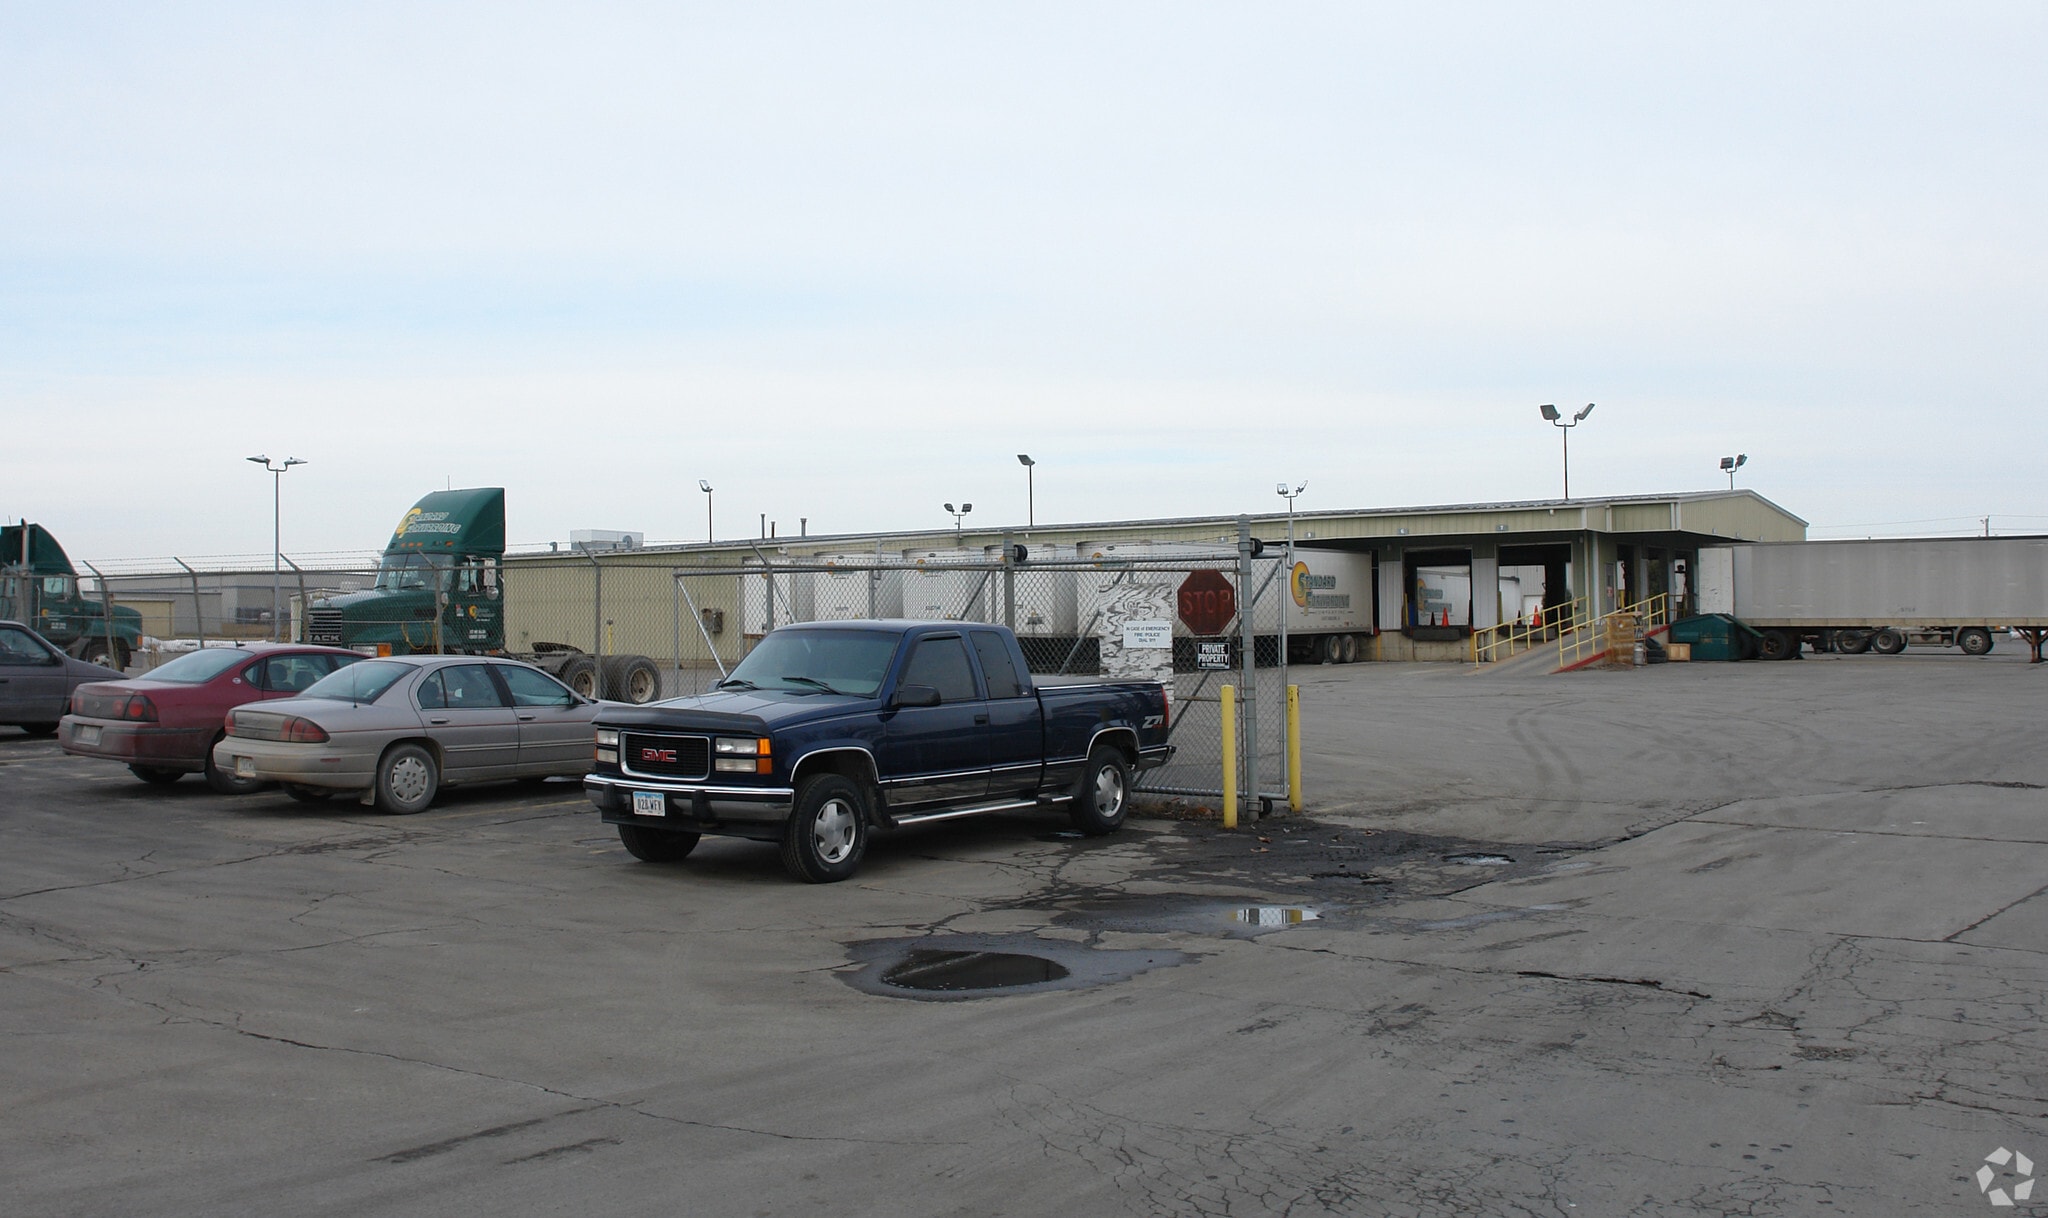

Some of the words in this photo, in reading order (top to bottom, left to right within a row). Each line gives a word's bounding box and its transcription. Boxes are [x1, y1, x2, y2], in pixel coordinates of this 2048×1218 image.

[1182, 589, 1231, 615] STOP
[1201, 644, 1225, 654] PRIVATE
[1198, 654, 1228, 663] PROPERTY
[1142, 714, 1164, 729] Z71
[641, 748, 677, 763] GMC
